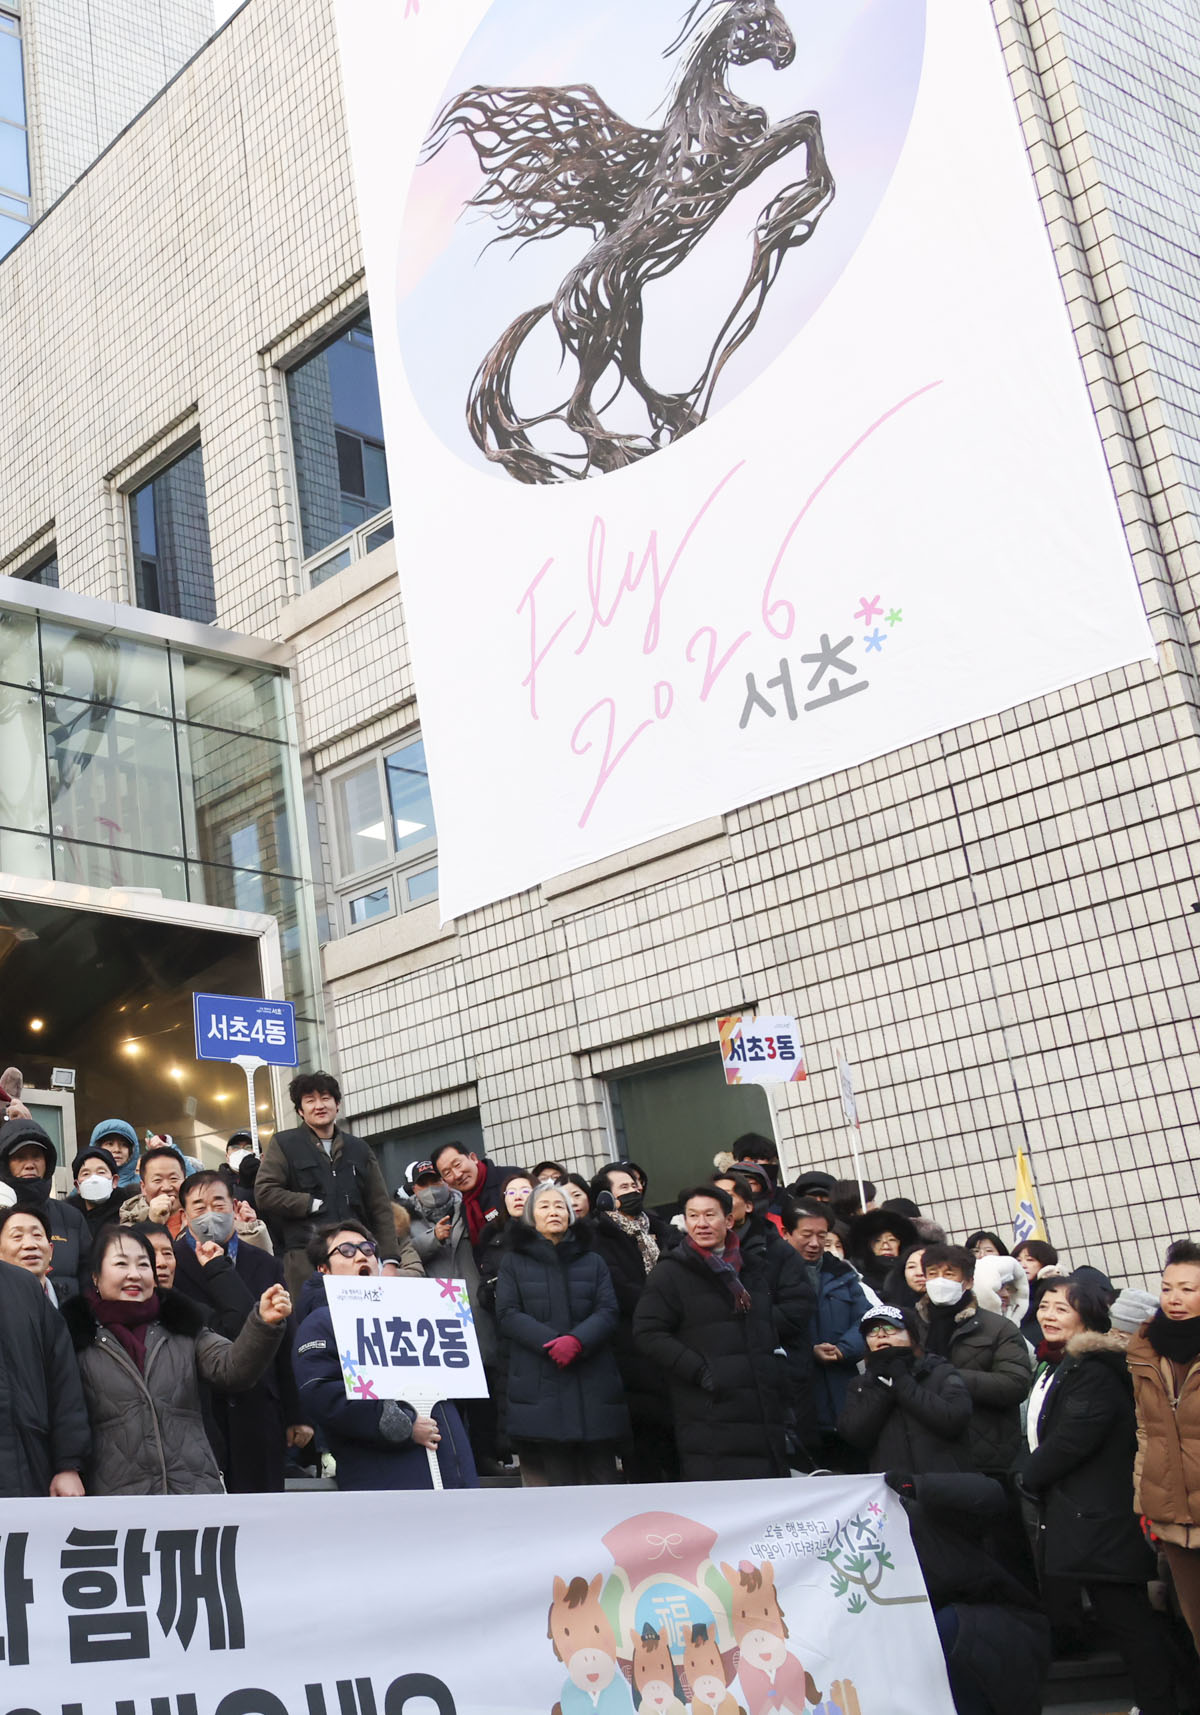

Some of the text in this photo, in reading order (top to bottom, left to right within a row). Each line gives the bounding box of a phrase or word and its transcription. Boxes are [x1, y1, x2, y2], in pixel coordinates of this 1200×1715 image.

[517, 460, 745, 720] Fly
[569, 380, 944, 829] 2026
[738, 633, 869, 729] 서초
[207, 1014, 287, 1046] 서초4동
[729, 1035, 796, 1063] 서초3동
[363, 1289, 381, 1302] 서초
[356, 1316, 470, 1368] 서초2동
[764, 1520, 830, 1539] 오늘 행복하고
[829, 1513, 881, 1553] 서초
[750, 1541, 785, 1560] 내일이
[59, 1525, 246, 1664] 함께
